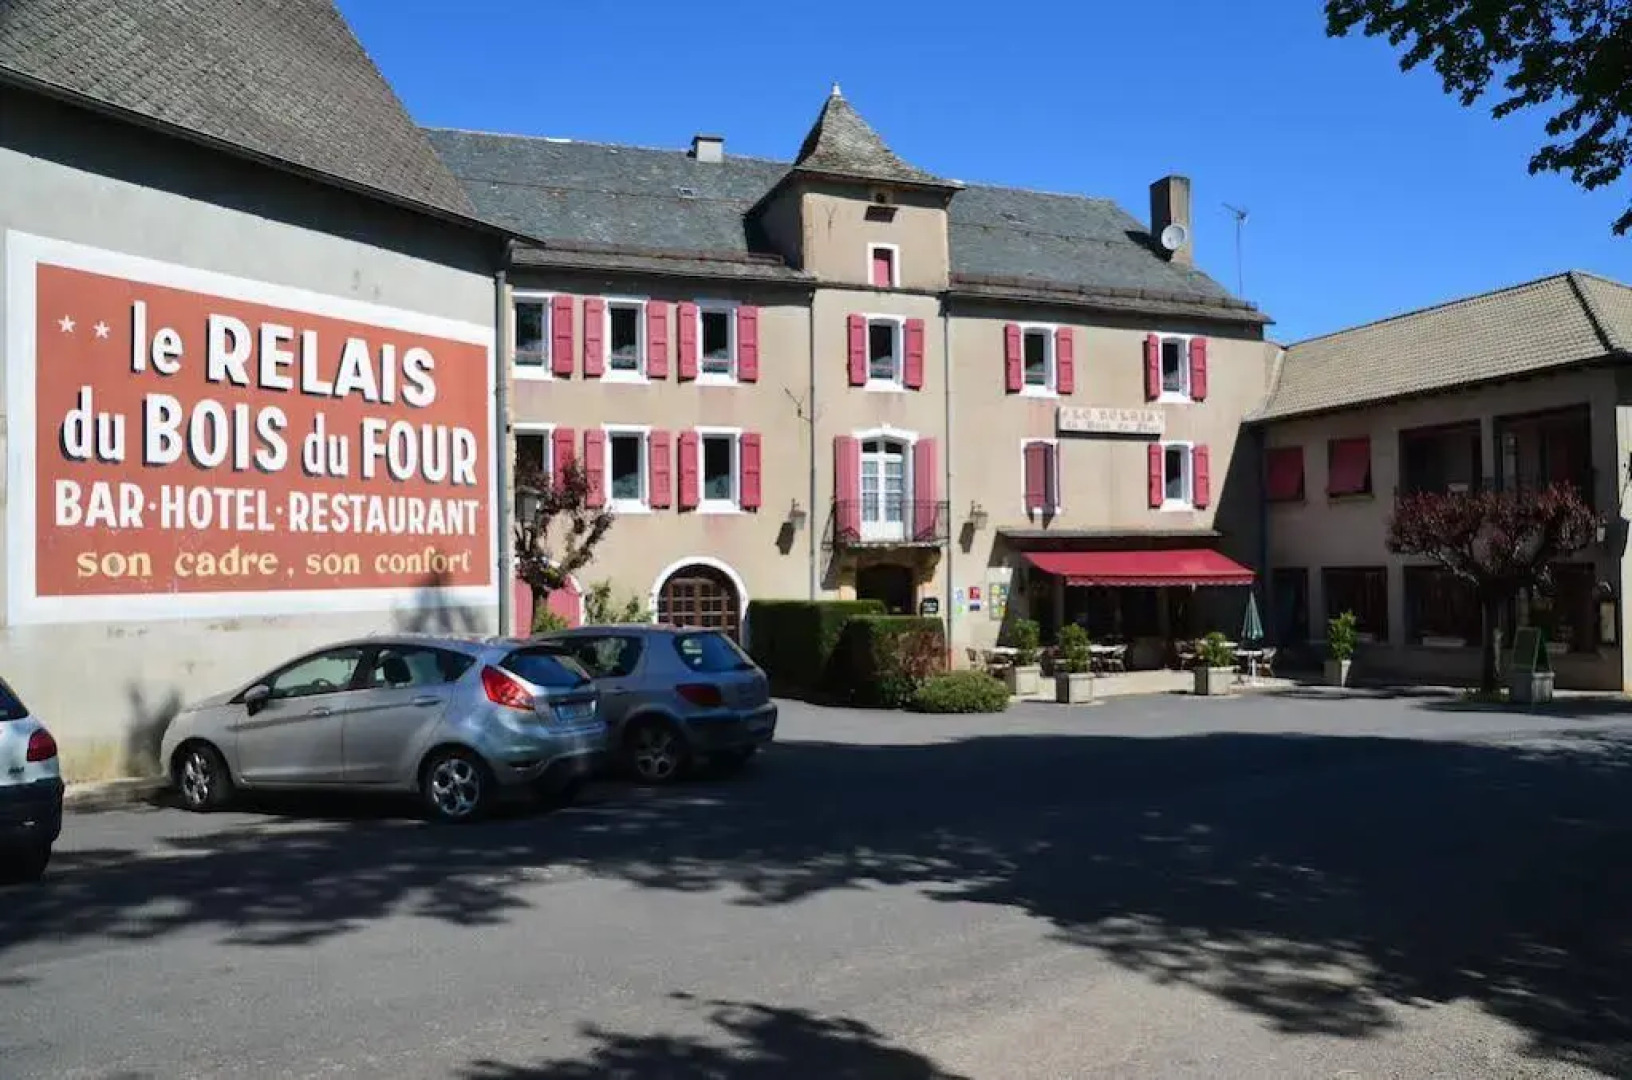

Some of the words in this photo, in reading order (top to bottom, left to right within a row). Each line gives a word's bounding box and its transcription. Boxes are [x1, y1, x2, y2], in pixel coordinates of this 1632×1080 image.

[130, 298, 186, 376] le
[206, 312, 437, 409] RELAIS
[61, 384, 126, 461] du
[144, 392, 289, 472] BOIS
[304, 412, 350, 477] du
[363, 417, 479, 485] FOUR
[76, 551, 154, 578] son
[305, 551, 361, 575] son
[374, 543, 472, 575] confort
